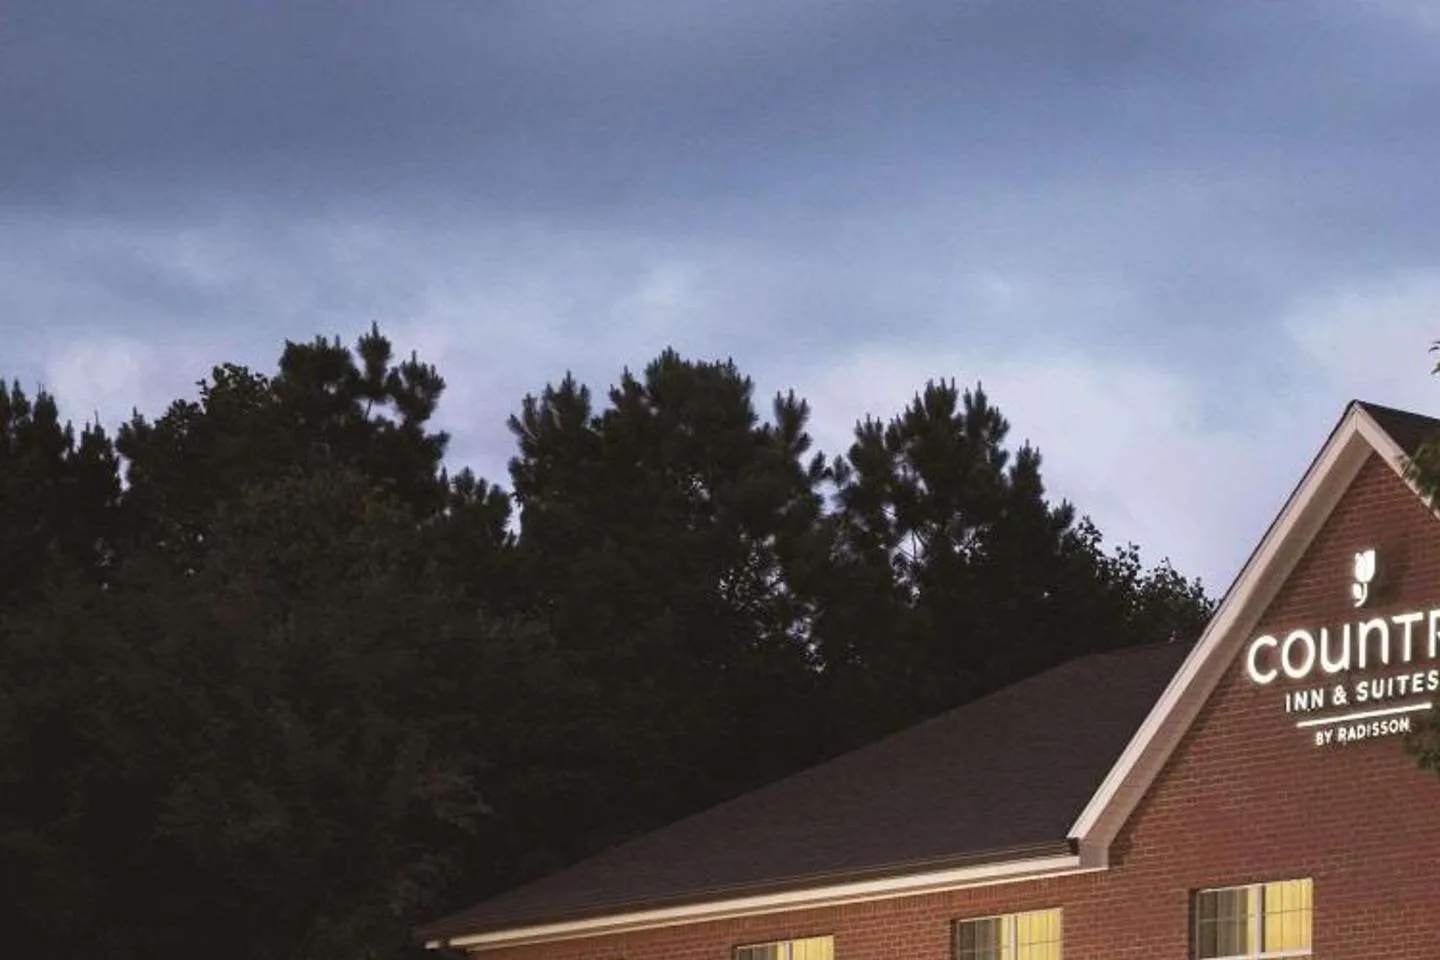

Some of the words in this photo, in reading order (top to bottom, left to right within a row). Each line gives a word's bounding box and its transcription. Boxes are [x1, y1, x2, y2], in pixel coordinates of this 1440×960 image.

[1285, 689, 1324, 712] INN
[1332, 684, 1348, 706] &
[1356, 669, 1440, 702] SUITES
[1315, 729, 1333, 746] BY
[1337, 716, 1411, 743] RADISSON
